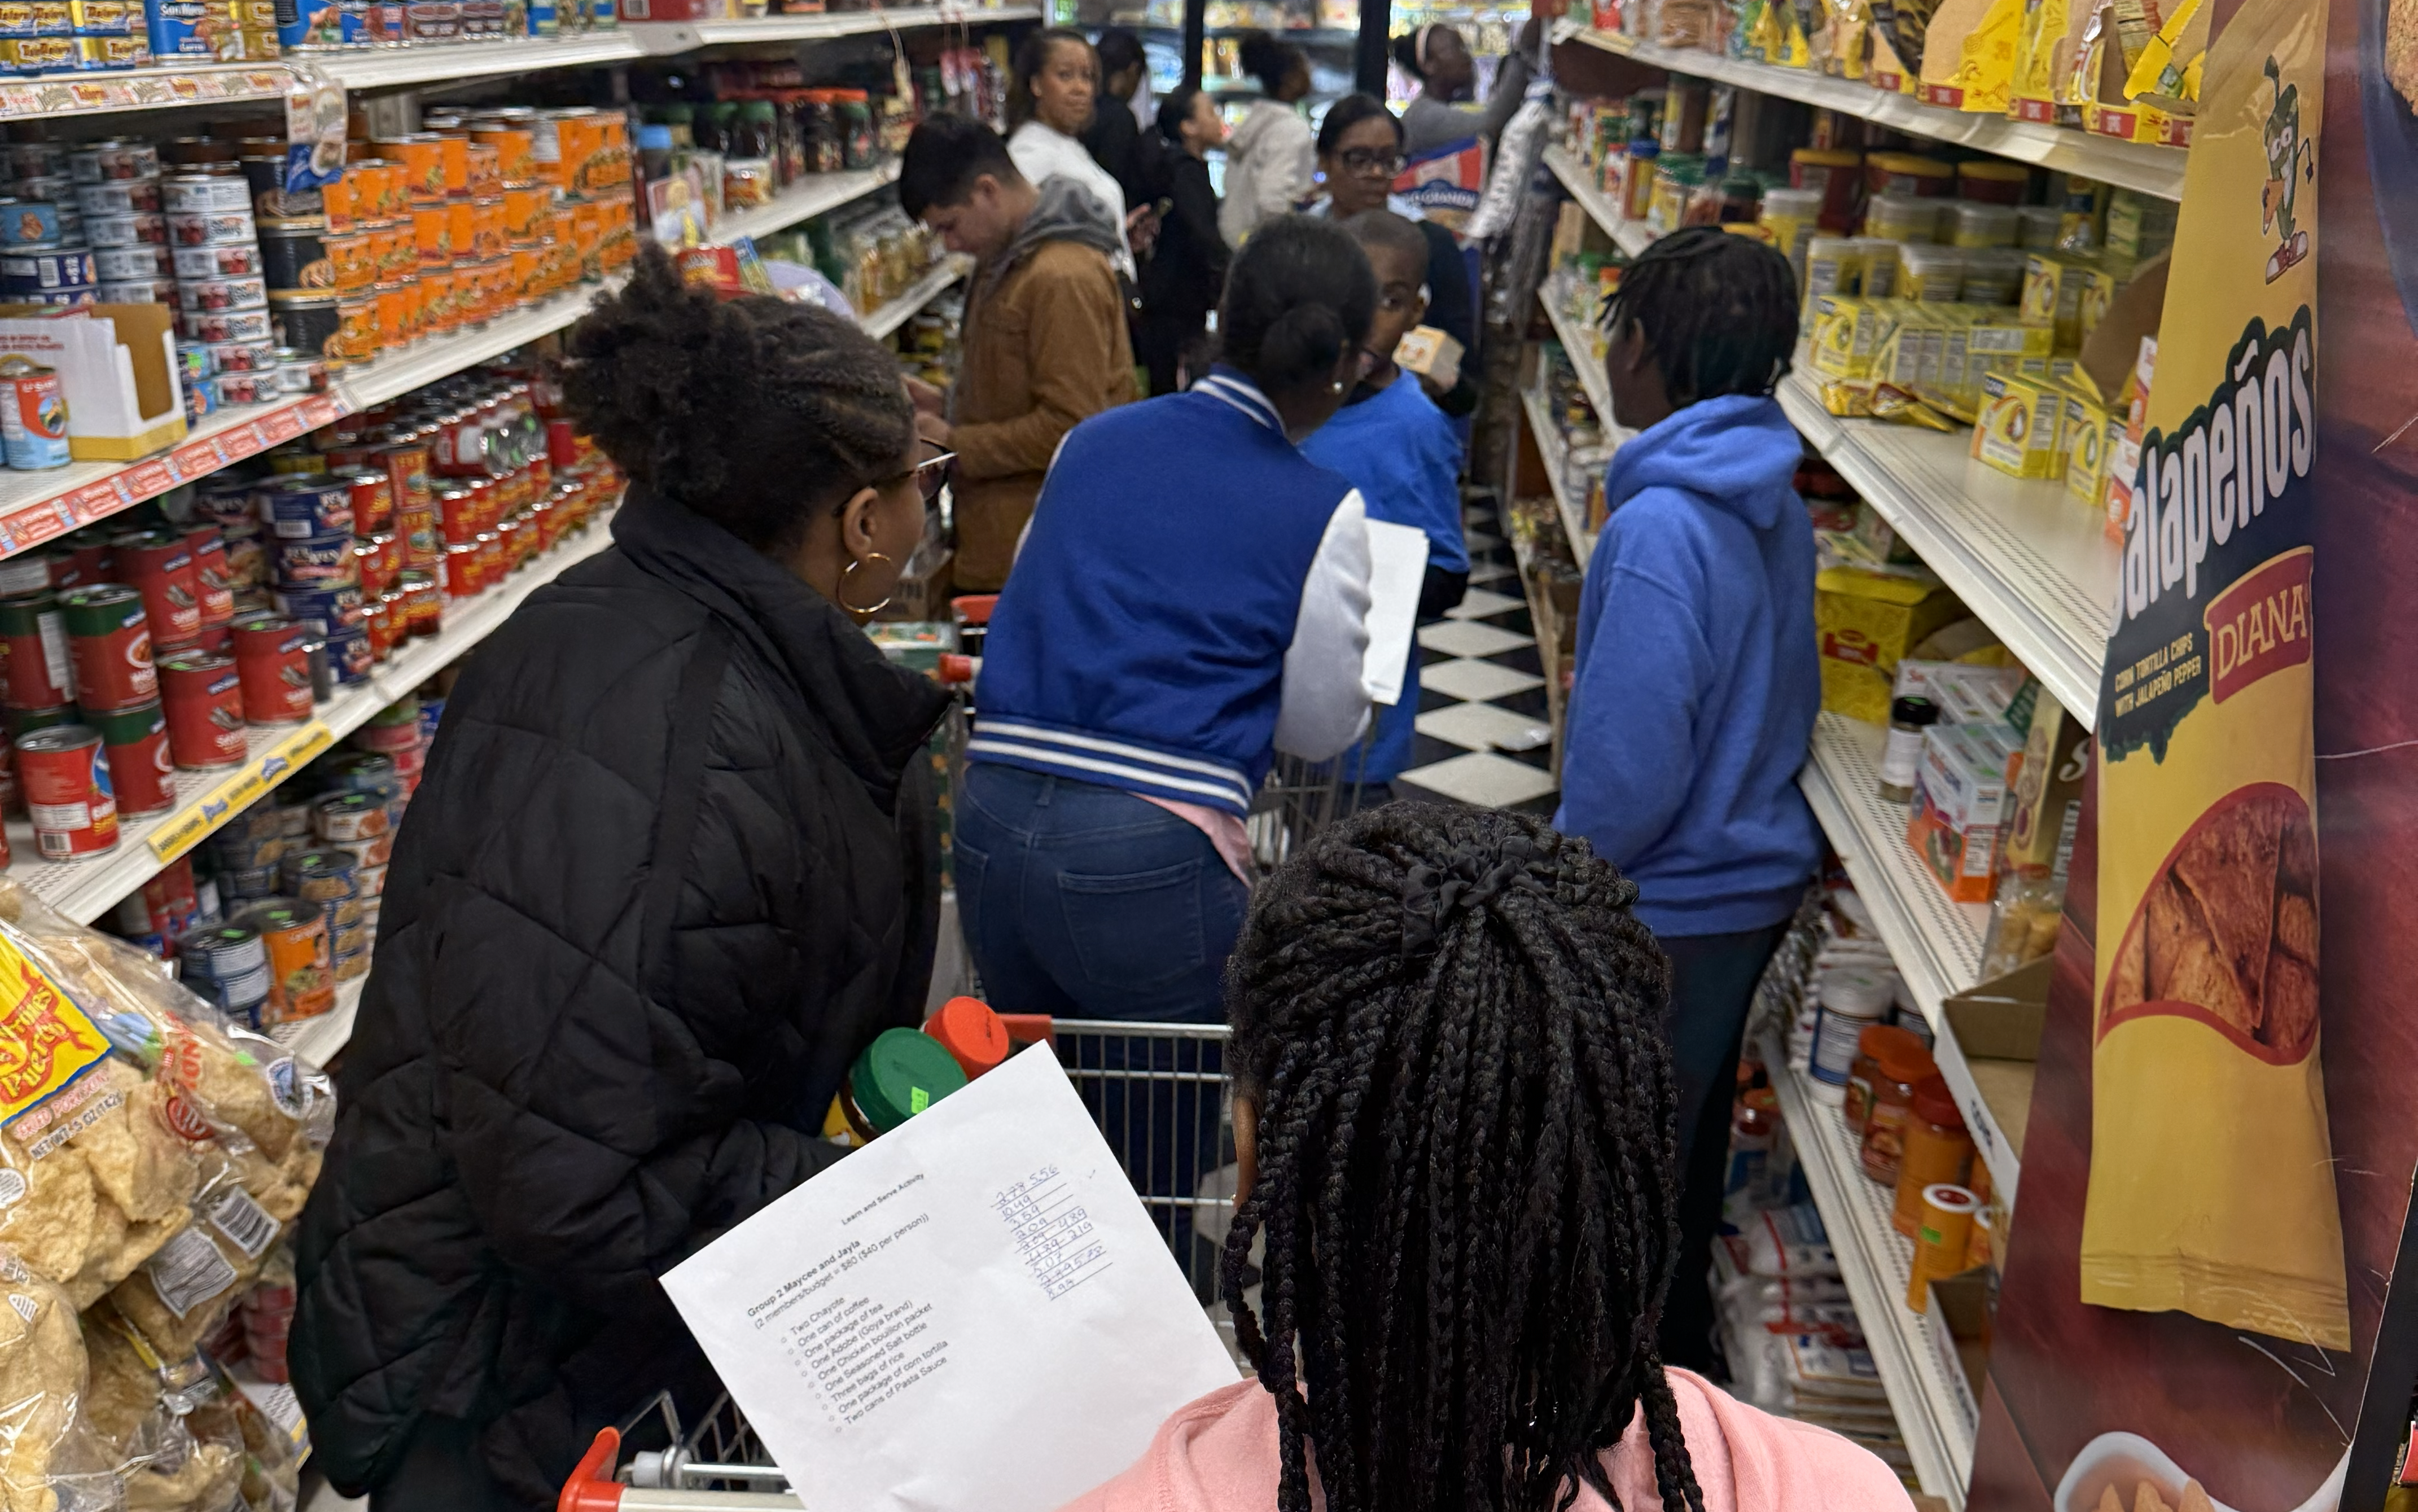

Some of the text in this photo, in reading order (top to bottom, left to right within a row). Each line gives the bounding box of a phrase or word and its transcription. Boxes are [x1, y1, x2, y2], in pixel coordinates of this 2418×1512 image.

[2115, 632, 2193, 693] CORN TORTILLA CHIPS
[2218, 586, 2307, 681] DIANA
[2115, 655, 2201, 717] WITH JALAPEÑO PEPPER
[841, 1173, 924, 1225] Learn and Serve Activity
[747, 1241, 861, 1317] Group 2 Maycee and Jayla
[755, 1318, 765, 1329] (2
[765, 1272, 834, 1322] members/budget
[840, 1256, 858, 1271] $80
[858, 1243, 878, 1261] ($40
[878, 1235, 892, 1250] per
[893, 1213, 929, 1239] person))
[790, 1297, 845, 1335] Two Chayote
[798, 1297, 870, 1348] One can of coffee
[803, 1304, 884, 1358] One package of tea
[811, 1353, 830, 1369] One
[858, 1318, 884, 1339] (Goya
[883, 1300, 913, 1322] brand)
[818, 1303, 932, 1380] One Chicken bouillon packet
[825, 1322, 927, 1391] One Seasoned Salt bottle
[830, 1352, 905, 1402] Three bags of rice
[838, 1341, 948, 1413] One package of corn tortilla
[844, 1357, 947, 1425] Two cans of Pasta Sauce
